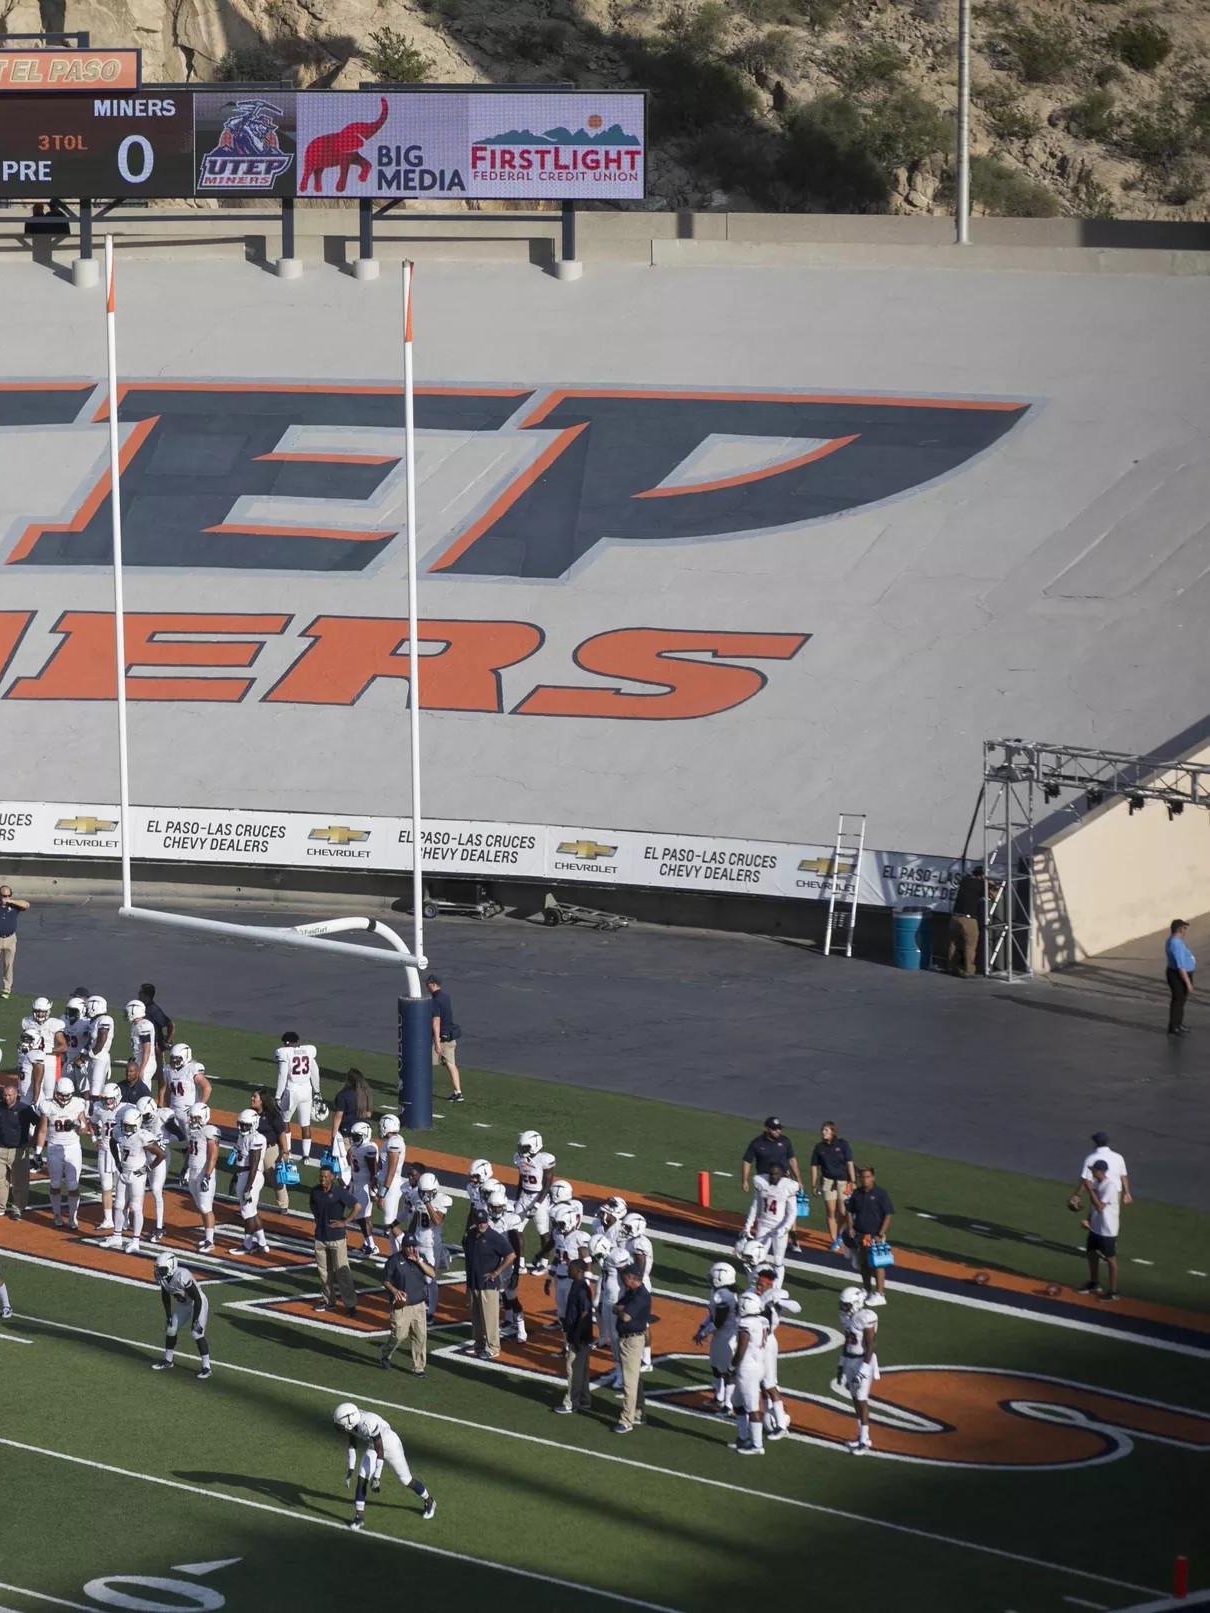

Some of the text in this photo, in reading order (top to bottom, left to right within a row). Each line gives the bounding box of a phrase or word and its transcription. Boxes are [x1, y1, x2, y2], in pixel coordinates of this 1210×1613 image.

[10, 60, 43, 84] EL
[48, 60, 122, 84] PASO
[94, 99, 176, 117] MINERS
[117, 135, 154, 183] 0
[377, 145, 423, 167] BIG
[2, 161, 52, 181] PRE
[206, 157, 287, 175] UTEP
[204, 177, 270, 185] MINERS
[377, 169, 465, 191] MEDIA
[474, 171, 638, 182] FEDERAL CREDIT UNION
[146, 820, 286, 839] EL PASO-LAS CRUCES
[53, 838, 119, 848] CHEVROLET
[163, 836, 269, 853] CHEVY DEALERS
[398, 830, 413, 843] EL
[485, 834, 536, 849] CRUCES
[306, 848, 371, 858] CHEVROLET
[420, 847, 519, 864] HEVY DEALERS
[644, 846, 777, 869] EL PASO-LAS CRUCES
[554, 861, 618, 874] CHEVROLET
[659, 863, 761, 883] CHEVY DEALERS
[882, 865, 897, 879] EL
[897, 882, 940, 898] CHEVY
[304, 926, 328, 936] FieldTurf
[292, 1056, 310, 1075] 23
[763, 1198, 777, 1215] 14
